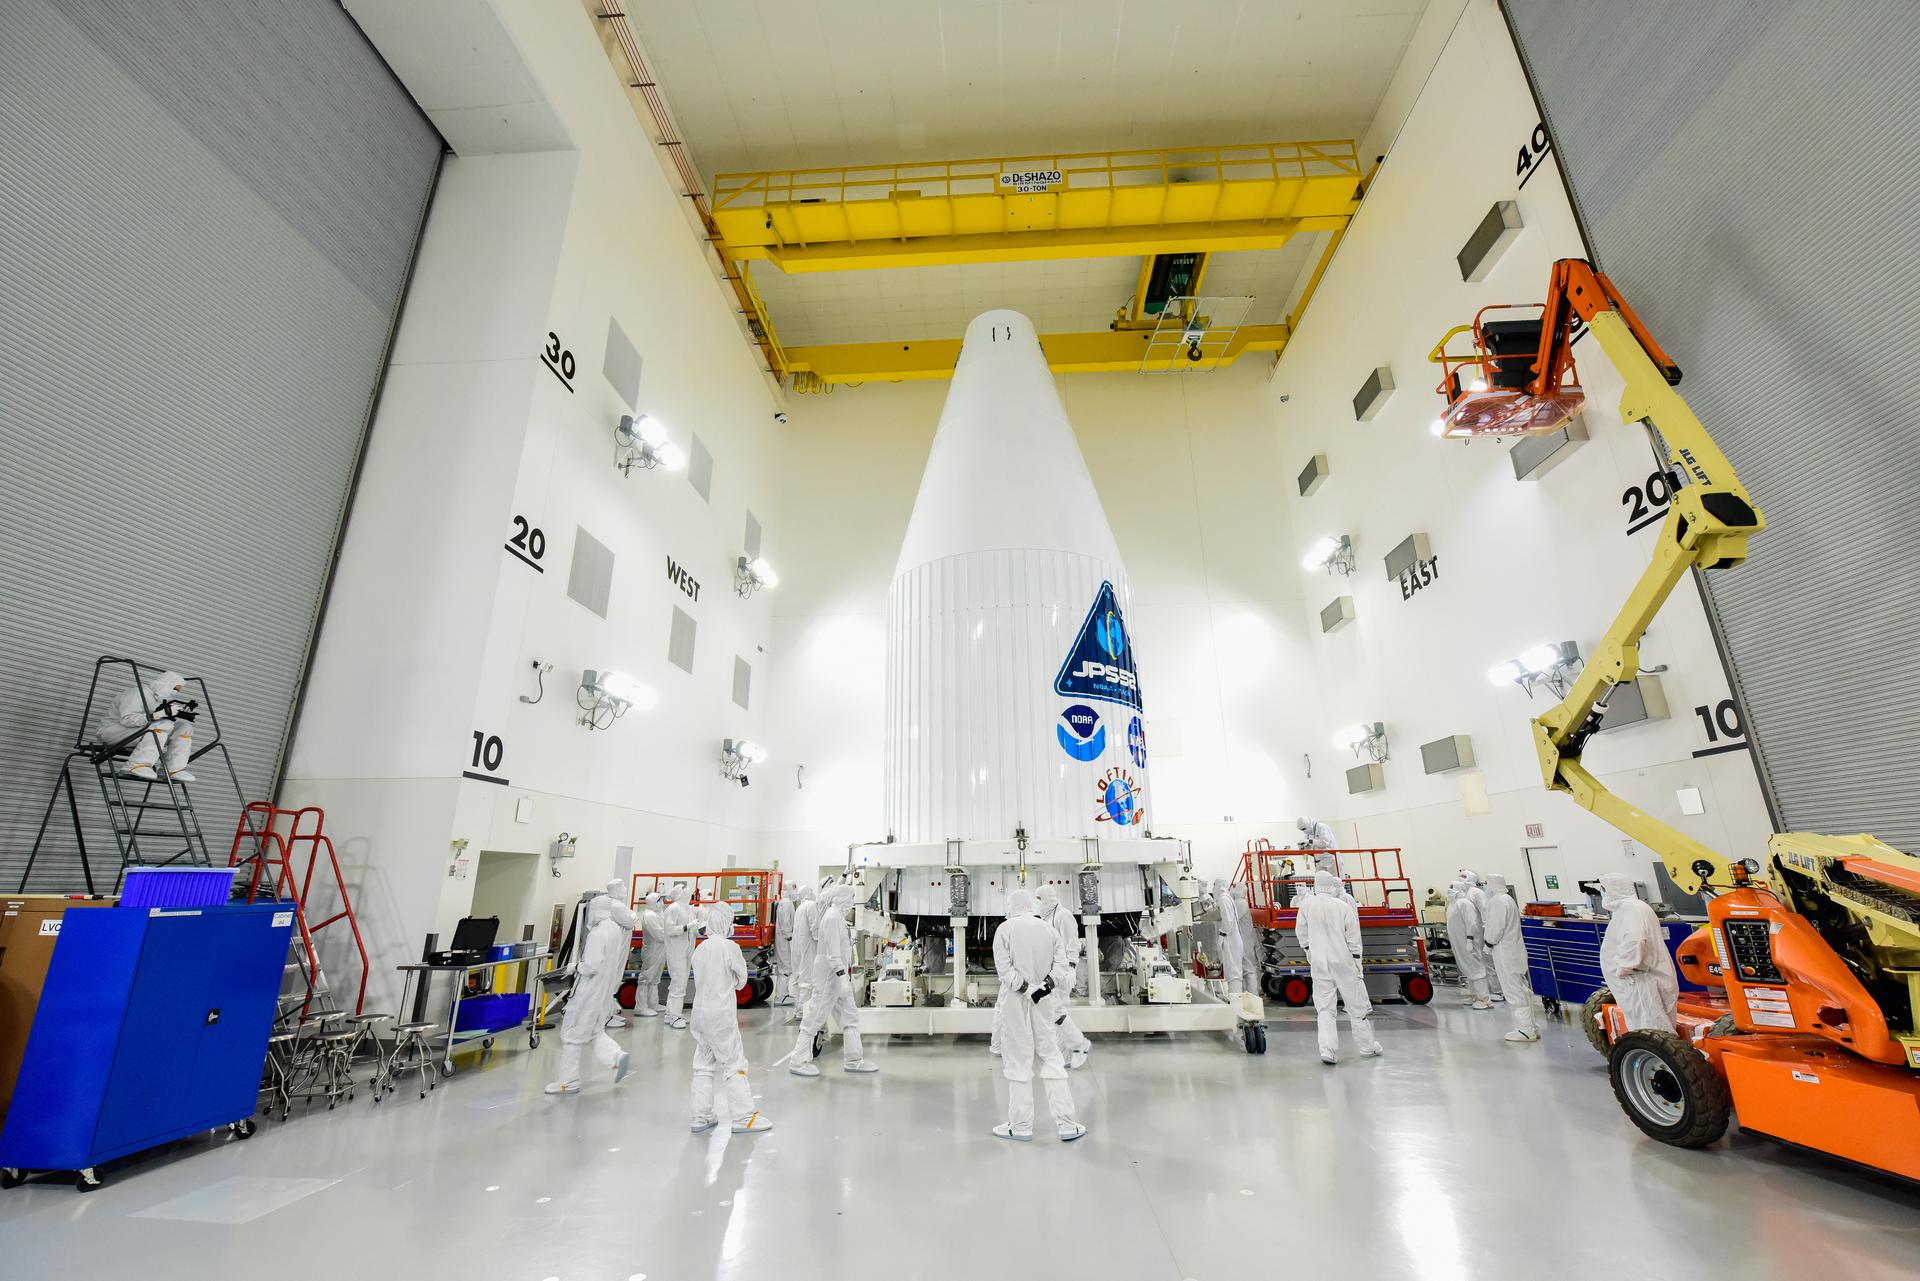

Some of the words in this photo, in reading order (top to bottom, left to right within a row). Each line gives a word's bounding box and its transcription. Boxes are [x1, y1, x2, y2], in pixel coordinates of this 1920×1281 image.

[1517, 122, 1548, 176] 40
[546, 331, 576, 380] 30
[1679, 448, 1697, 465] JLG
[1692, 465, 1713, 486] LIFT
[1622, 471, 1670, 525] 20
[510, 515, 546, 560] 20
[666, 555, 701, 603] WEST
[1400, 555, 1439, 601] EAST
[1695, 699, 1745, 742] 10
[472, 730, 504, 772] 10
[1096, 767, 1134, 804] LOFTID
